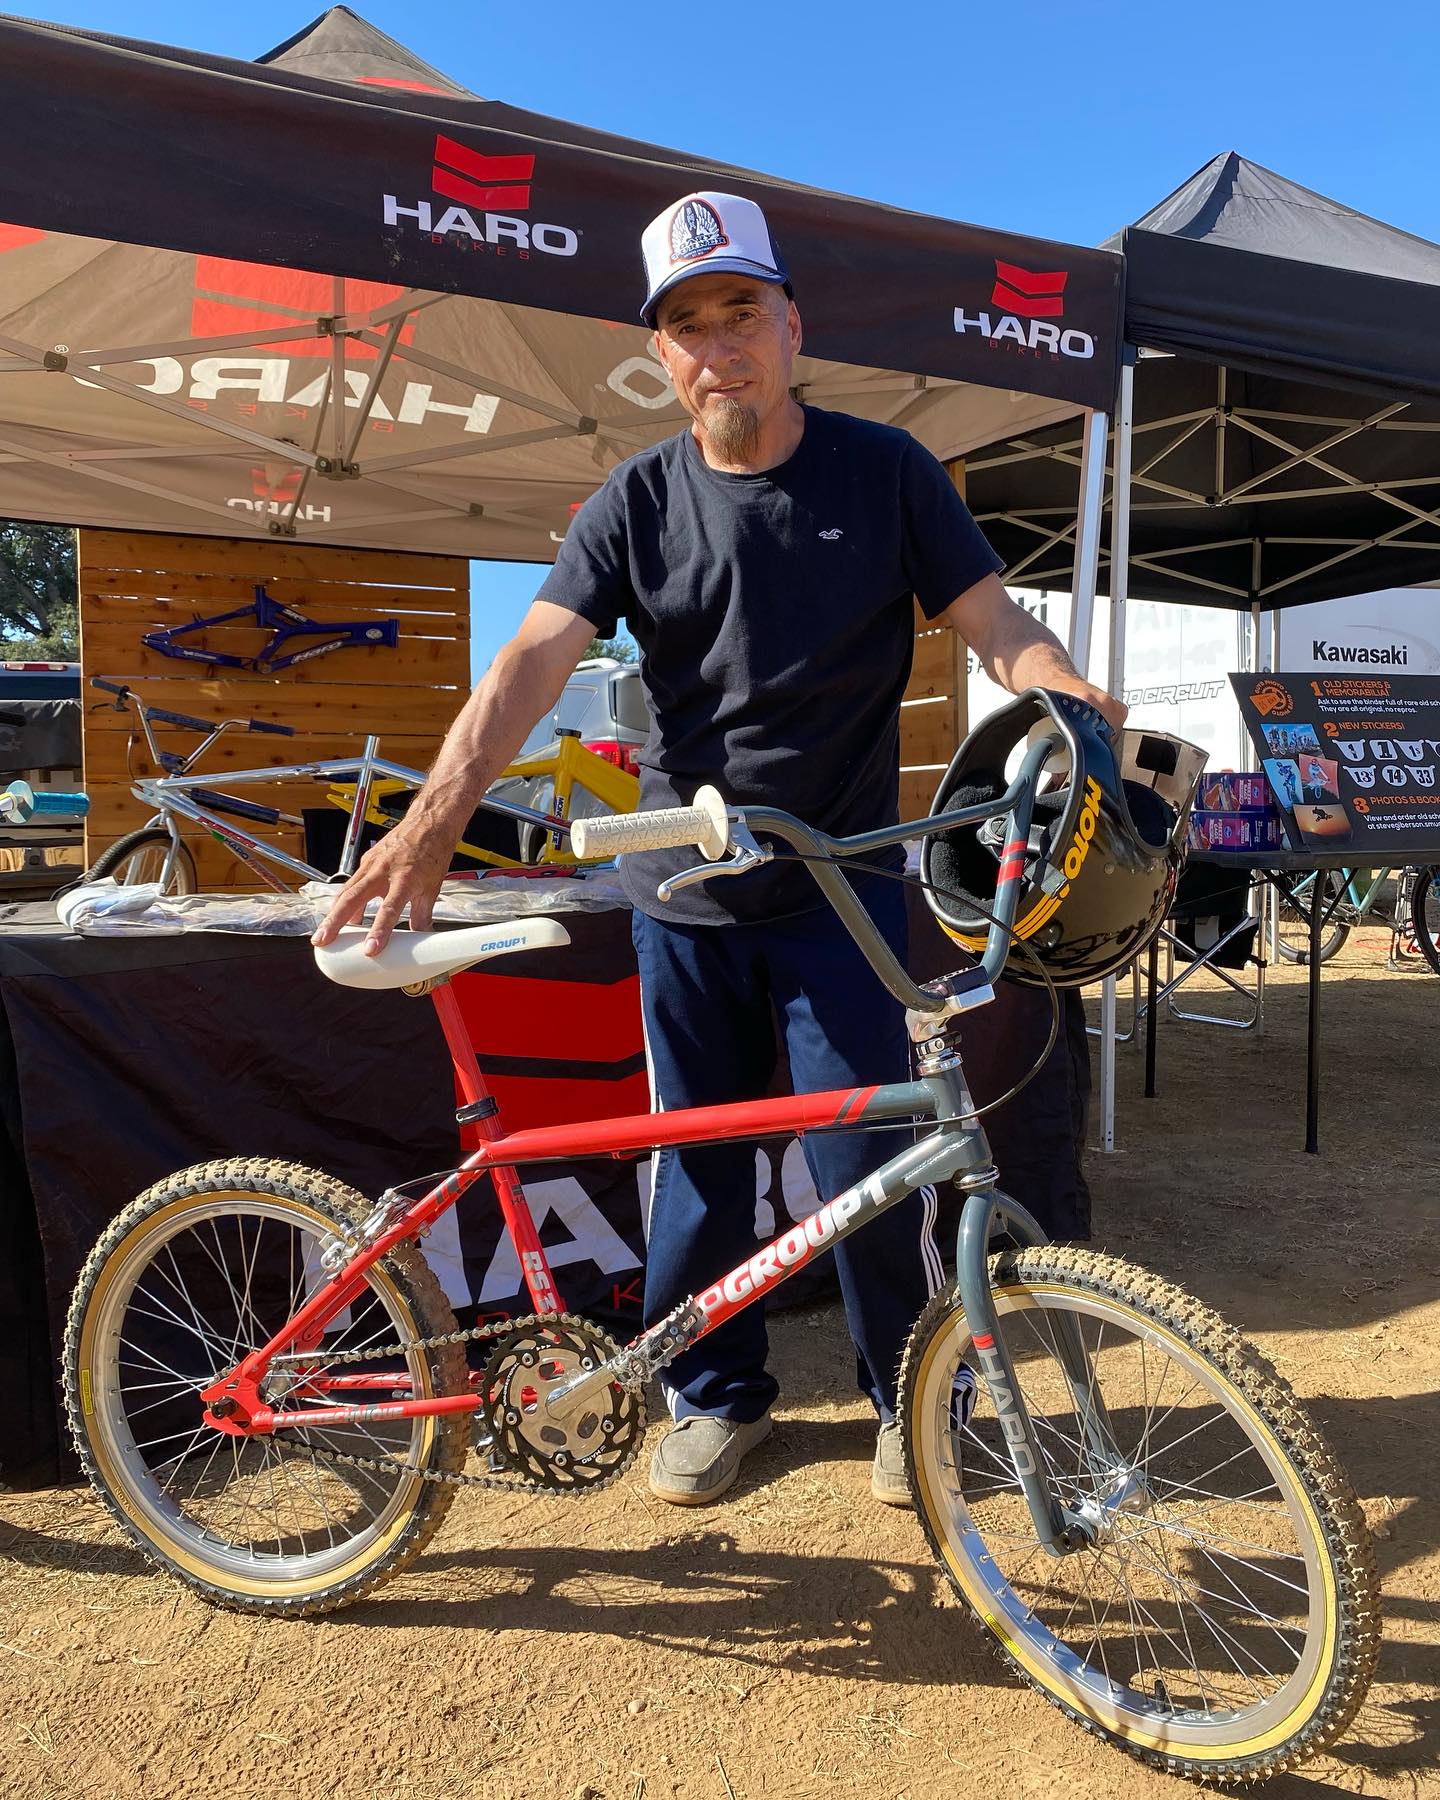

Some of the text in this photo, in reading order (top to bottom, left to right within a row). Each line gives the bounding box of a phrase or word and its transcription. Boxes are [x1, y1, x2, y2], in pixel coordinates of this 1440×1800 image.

[383, 193, 578, 257] HARO
[431, 234, 530, 260] BIKES
[953, 306, 1094, 359] HARO
[1312, 640, 1408, 665] Kawasaki
[1142, 680, 1226, 706] CIRCUIT
[1310, 681, 1324, 697] 1
[1323, 680, 1341, 688] OLD
[1342, 680, 1383, 689] STICKERS
[1325, 688, 1390, 697] MEMORABILIA!
[1319, 705, 1337, 713] They
[1322, 722, 1405, 737] 2 NEW STICKERS!
[1416, 770, 1432, 784] 33
[1353, 796, 1371, 814] 3
[1370, 796, 1408, 804] PHOTOS
[1363, 814, 1382, 822] View
[1383, 813, 1397, 821] and
[1417, 812, 1428, 820] old
[1064, 775, 1102, 880] MOTO
[977, 1347, 1037, 1476] HARO
[581, 1449, 603, 1465] HARO
